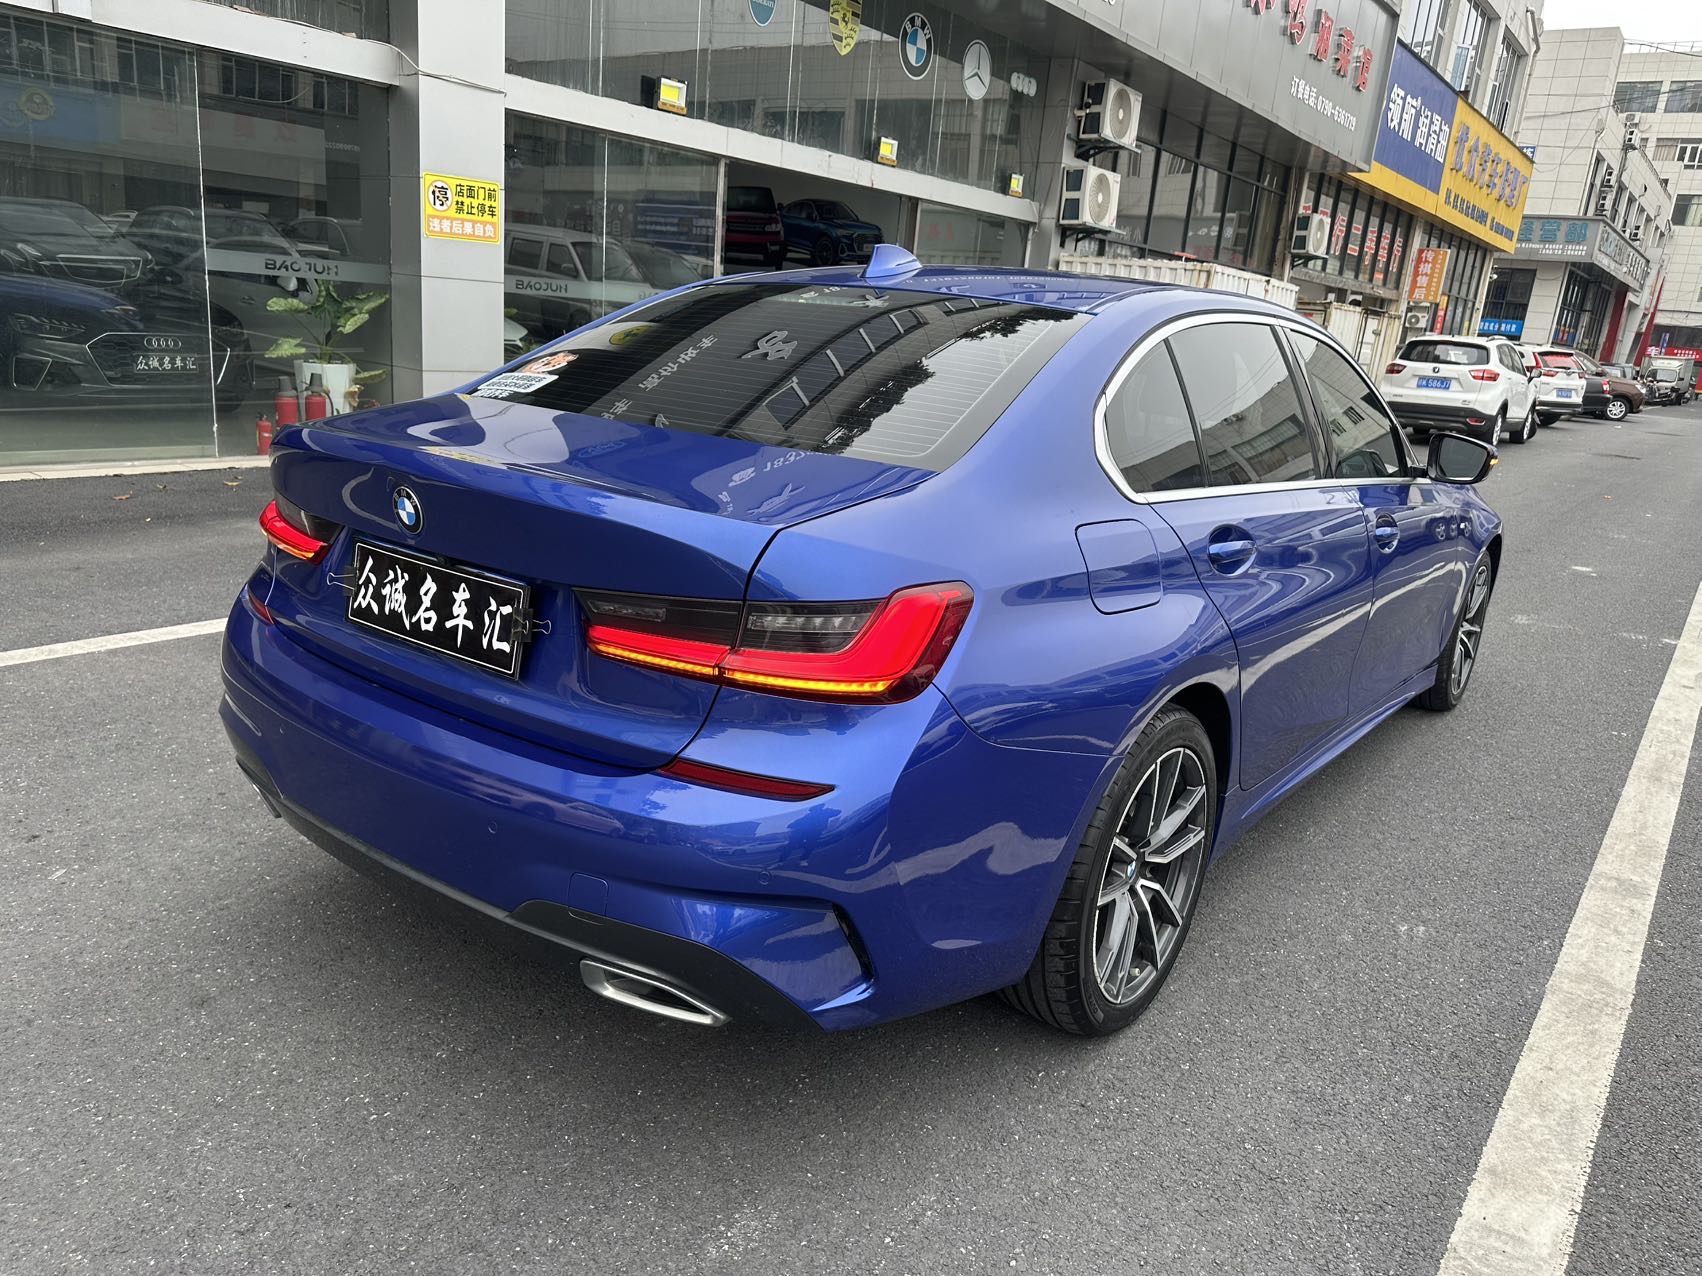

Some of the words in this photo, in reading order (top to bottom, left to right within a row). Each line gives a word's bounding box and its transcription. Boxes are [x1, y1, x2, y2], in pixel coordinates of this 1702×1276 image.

[905, 15, 931, 40] BMW
[431, 185, 449, 206] 停
[455, 183, 497, 202] 店面门前
[455, 200, 497, 218] 禁止停车
[429, 217, 495, 237] 违者后果自负
[1413, 250, 1434, 300] 传祺售后
[136, 355, 197, 371] 众诚名车汇
[394, 488, 416, 505] BMW
[353, 555, 513, 653] 众诚名车汇
